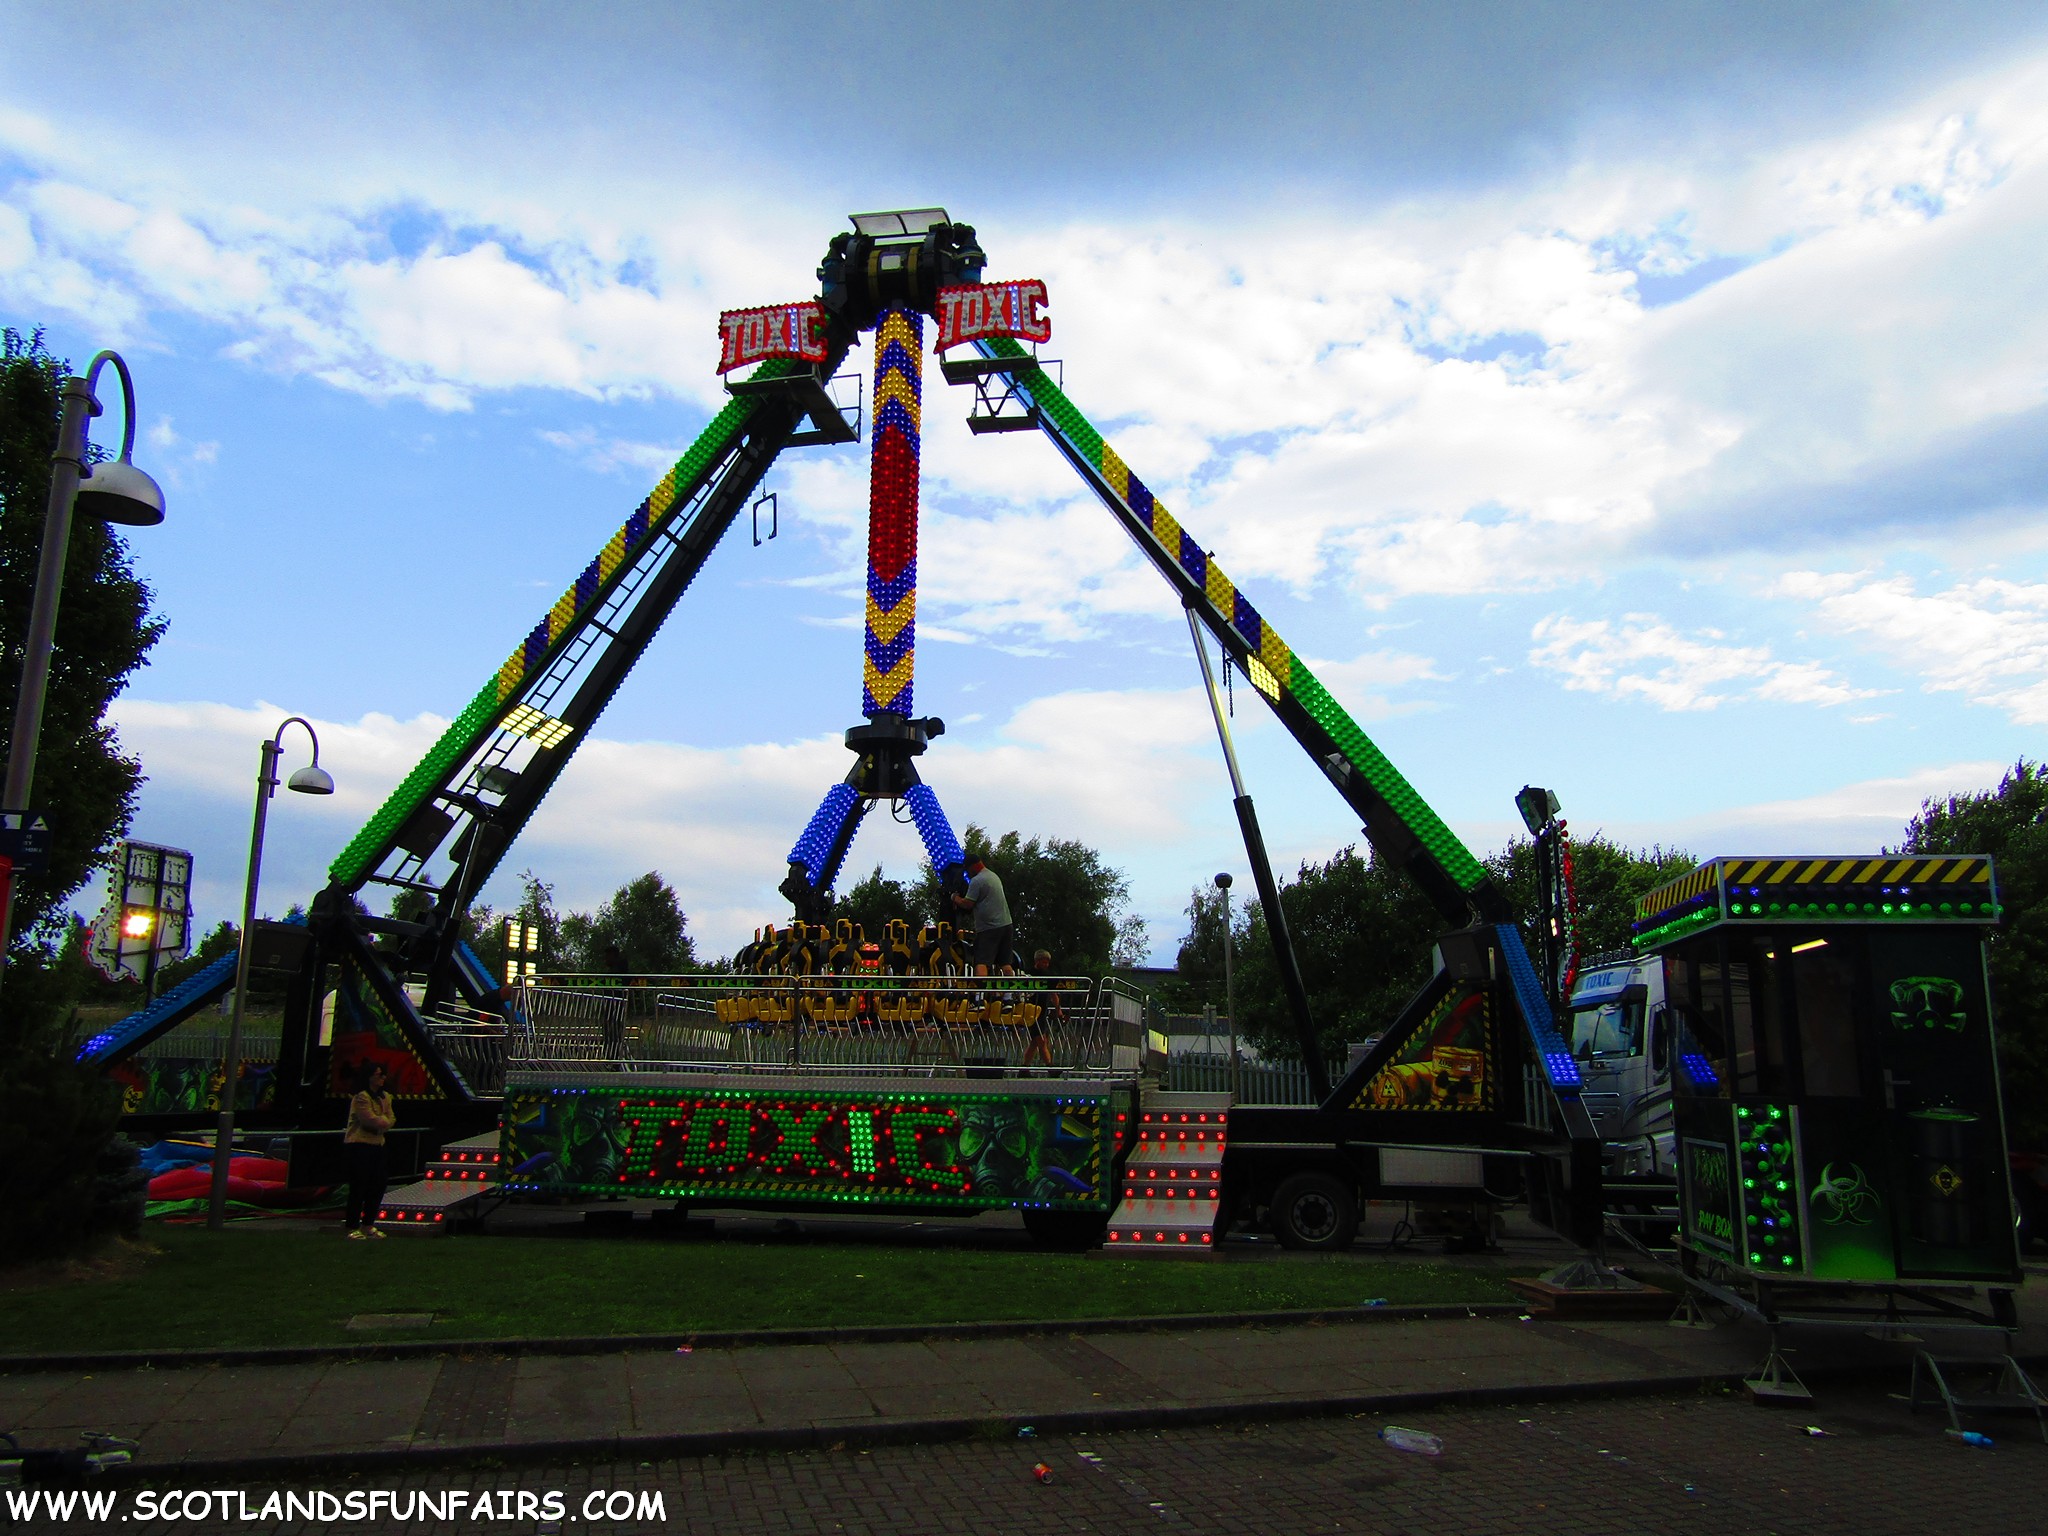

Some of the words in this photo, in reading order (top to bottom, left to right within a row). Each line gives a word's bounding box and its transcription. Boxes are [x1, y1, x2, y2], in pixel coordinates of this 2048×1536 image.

[940, 285, 1048, 344] TOXIC
[720, 307, 823, 366] TOXIC
[566, 978, 623, 987] TOXIC
[696, 979, 754, 988] TOXIC
[840, 979, 902, 989] TOXIC
[984, 980, 1049, 990] TOXIC
[1586, 971, 1614, 990] TOXIC
[616, 1099, 974, 1193] TOXIC
